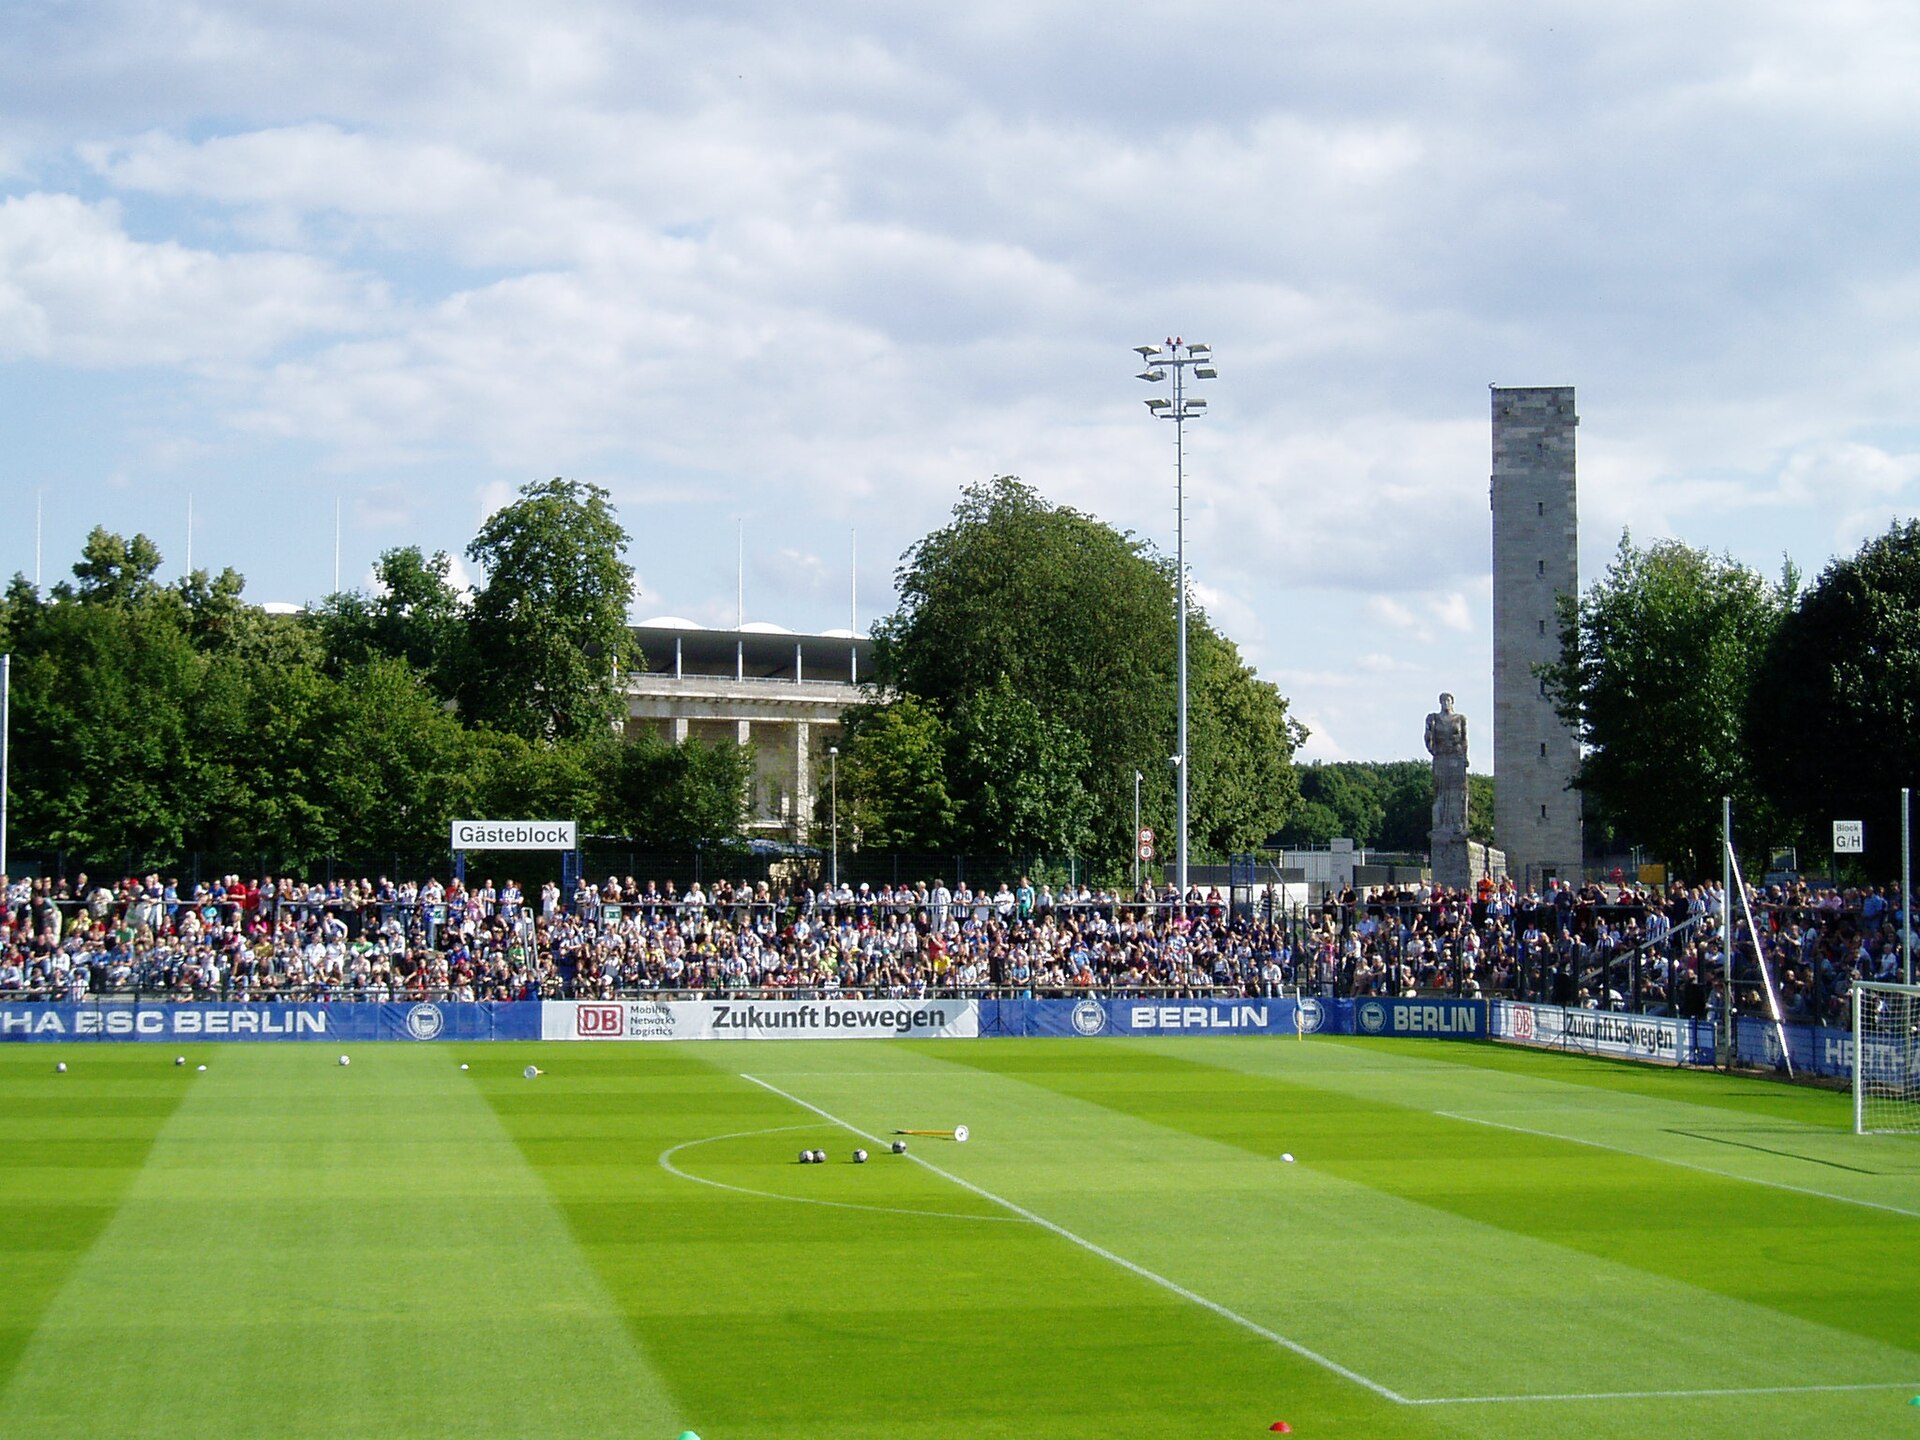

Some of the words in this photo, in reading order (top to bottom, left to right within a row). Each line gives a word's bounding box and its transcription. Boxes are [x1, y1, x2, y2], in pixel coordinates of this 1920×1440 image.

[459, 825, 569, 843] Gästeblock
[1836, 824, 1859, 832] Block
[1836, 835, 1861, 848] G/H
[583, 1009, 618, 1031] DB
[630, 1004, 671, 1015] Mobility
[630, 1016, 676, 1025] Networks
[712, 1005, 819, 1029] Zukunft
[824, 1006, 945, 1033] bewegen
[1131, 1006, 1268, 1028] BERLIN
[1393, 1005, 1476, 1032] BERLIN
[0, 1011, 66, 1033] HA
[75, 1011, 165, 1033] BSC
[174, 1010, 326, 1033] BERLIN
[630, 1026, 674, 1037] Logistics
[1515, 1009, 1531, 1034] DB
[1566, 1014, 1614, 1042] Zukunft
[1615, 1018, 1673, 1053] bewegen
